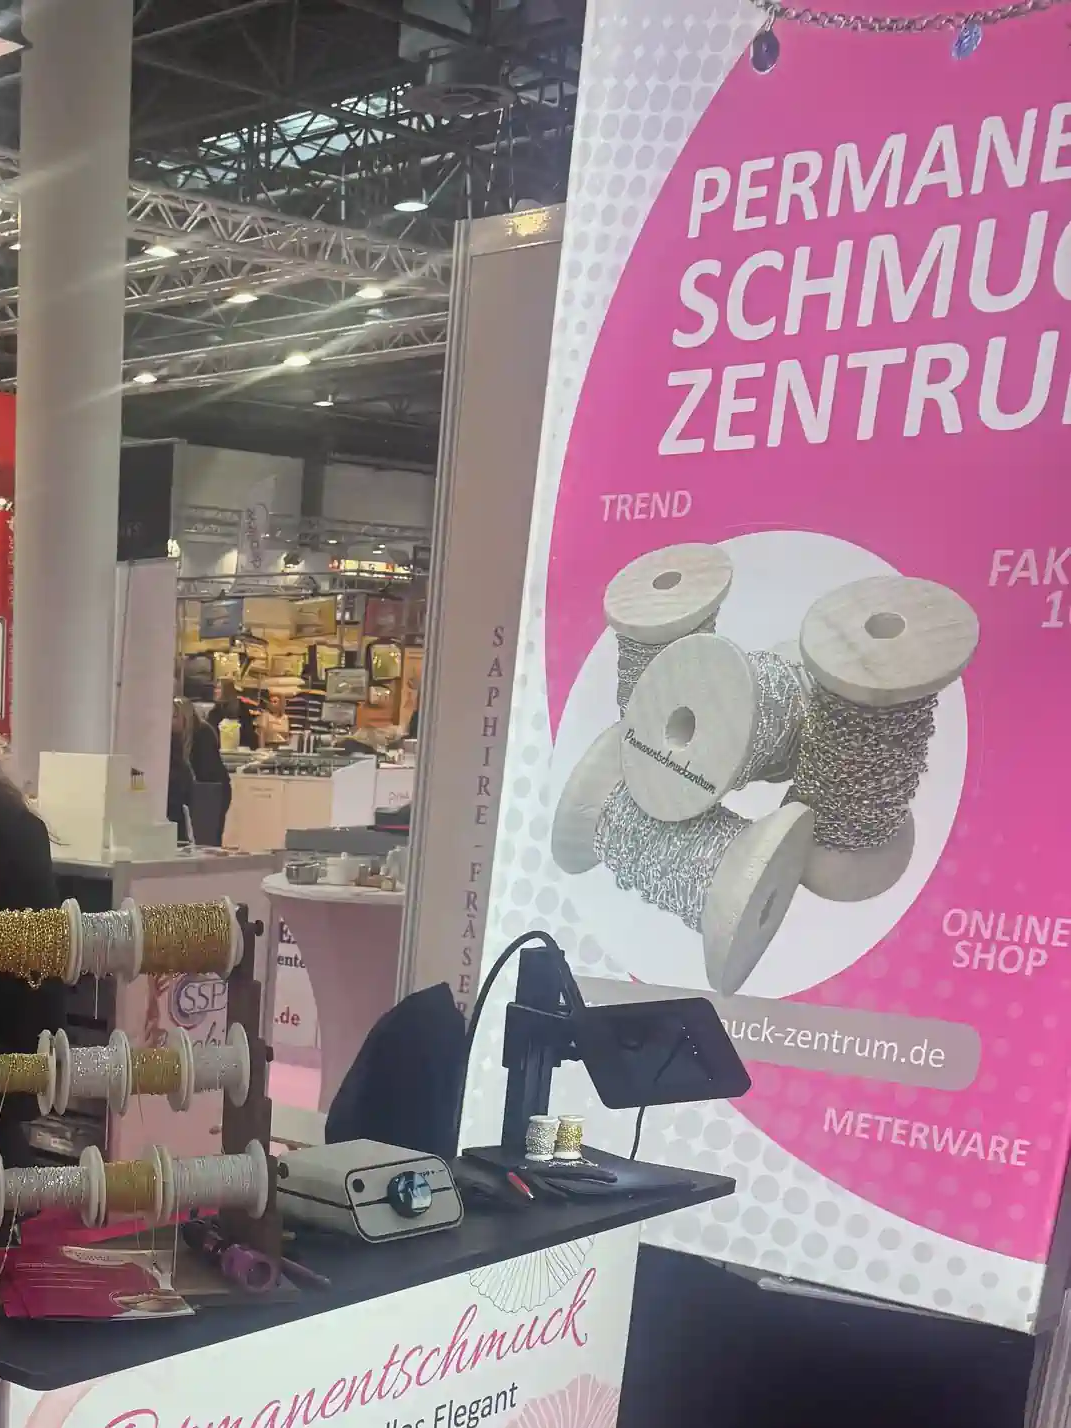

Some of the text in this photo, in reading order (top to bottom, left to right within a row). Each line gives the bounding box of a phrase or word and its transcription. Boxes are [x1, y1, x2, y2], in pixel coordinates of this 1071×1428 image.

[688, 101, 1071, 239] PERMANE
[672, 211, 1071, 348] SCHMU
[658, 331, 1071, 456] ZENTRU
[600, 490, 692, 522] TREND
[943, 908, 1071, 948] ONLINE
[953, 940, 1048, 976] SHOP
[823, 1107, 1032, 1168] METERWARE
